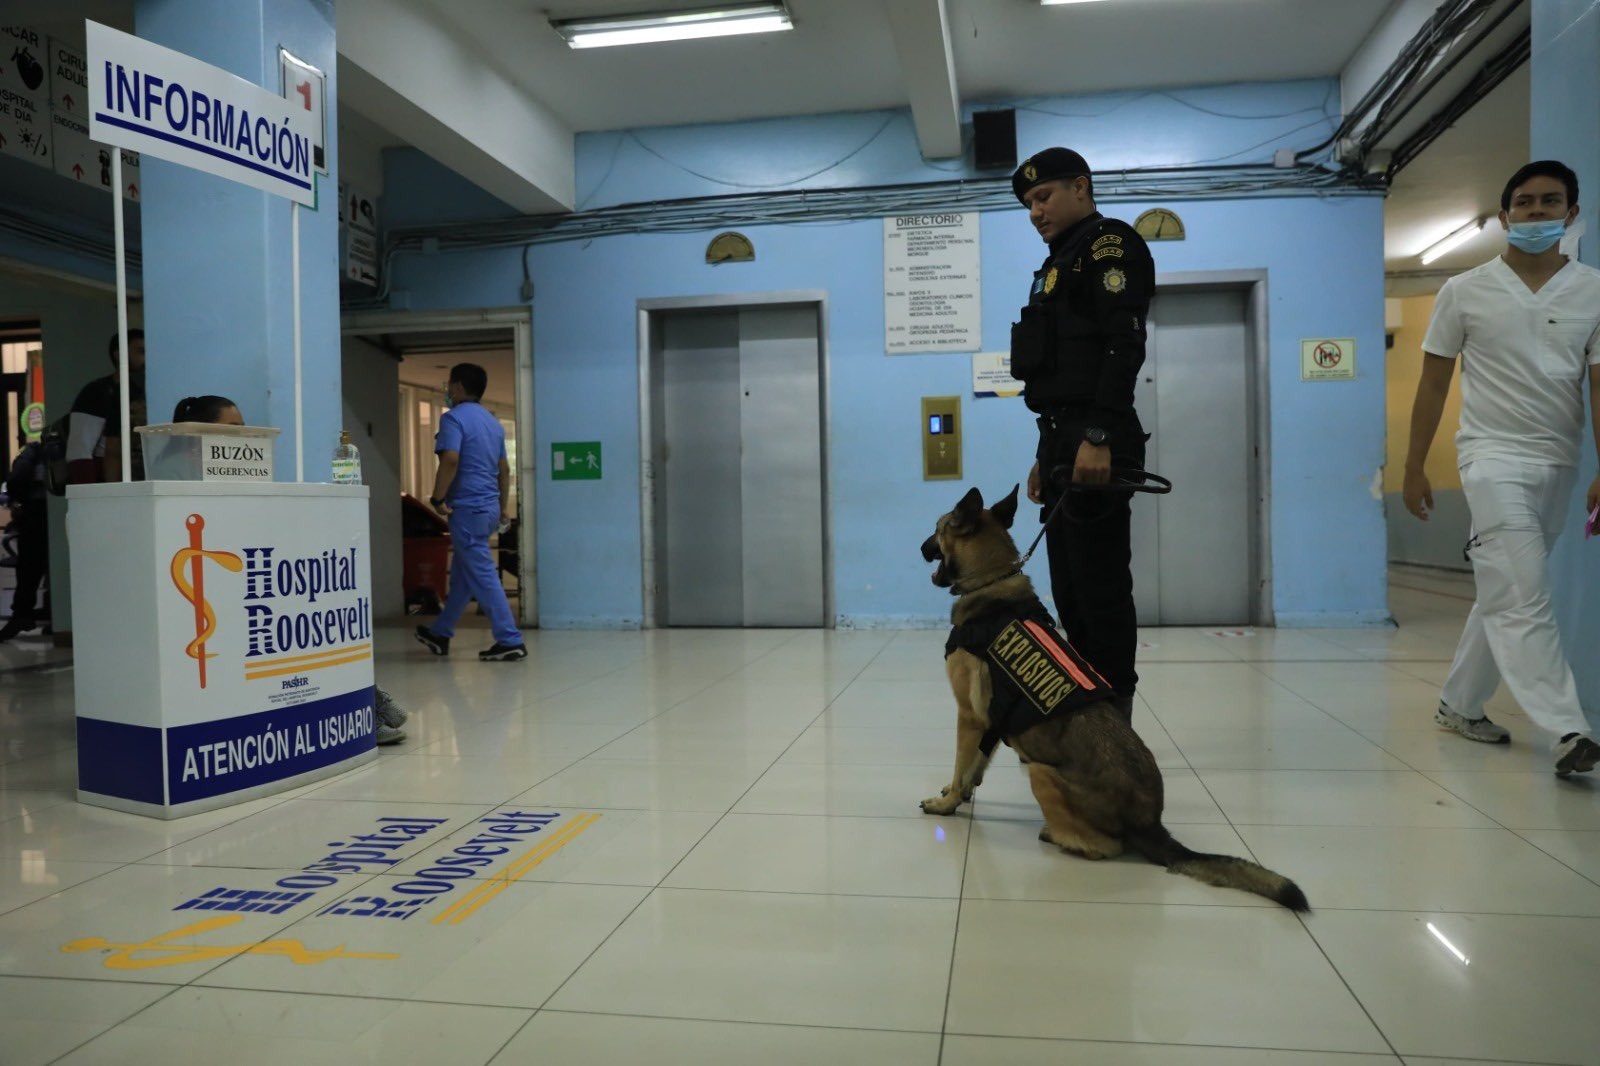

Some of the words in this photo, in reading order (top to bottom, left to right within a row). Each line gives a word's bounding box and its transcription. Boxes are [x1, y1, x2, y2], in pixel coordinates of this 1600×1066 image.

[58, 49, 87, 72] CIRU
[0, 88, 38, 113] SPITAL
[104, 60, 310, 178] INFORMACIÓN
[896, 214, 963, 226] DIRECTORIO
[206, 465, 269, 478] SUGERENCIAS
[242, 546, 357, 604] Hospital
[243, 596, 372, 658] Roosevelt
[993, 624, 1073, 709] EXPLOSIVOS
[182, 722, 290, 783] ATENCIÓN
[294, 731, 317, 763] AL
[318, 706, 374, 750] USUARIO
[172, 815, 451, 917] Hospital
[315, 810, 563, 922] Roosevelt
